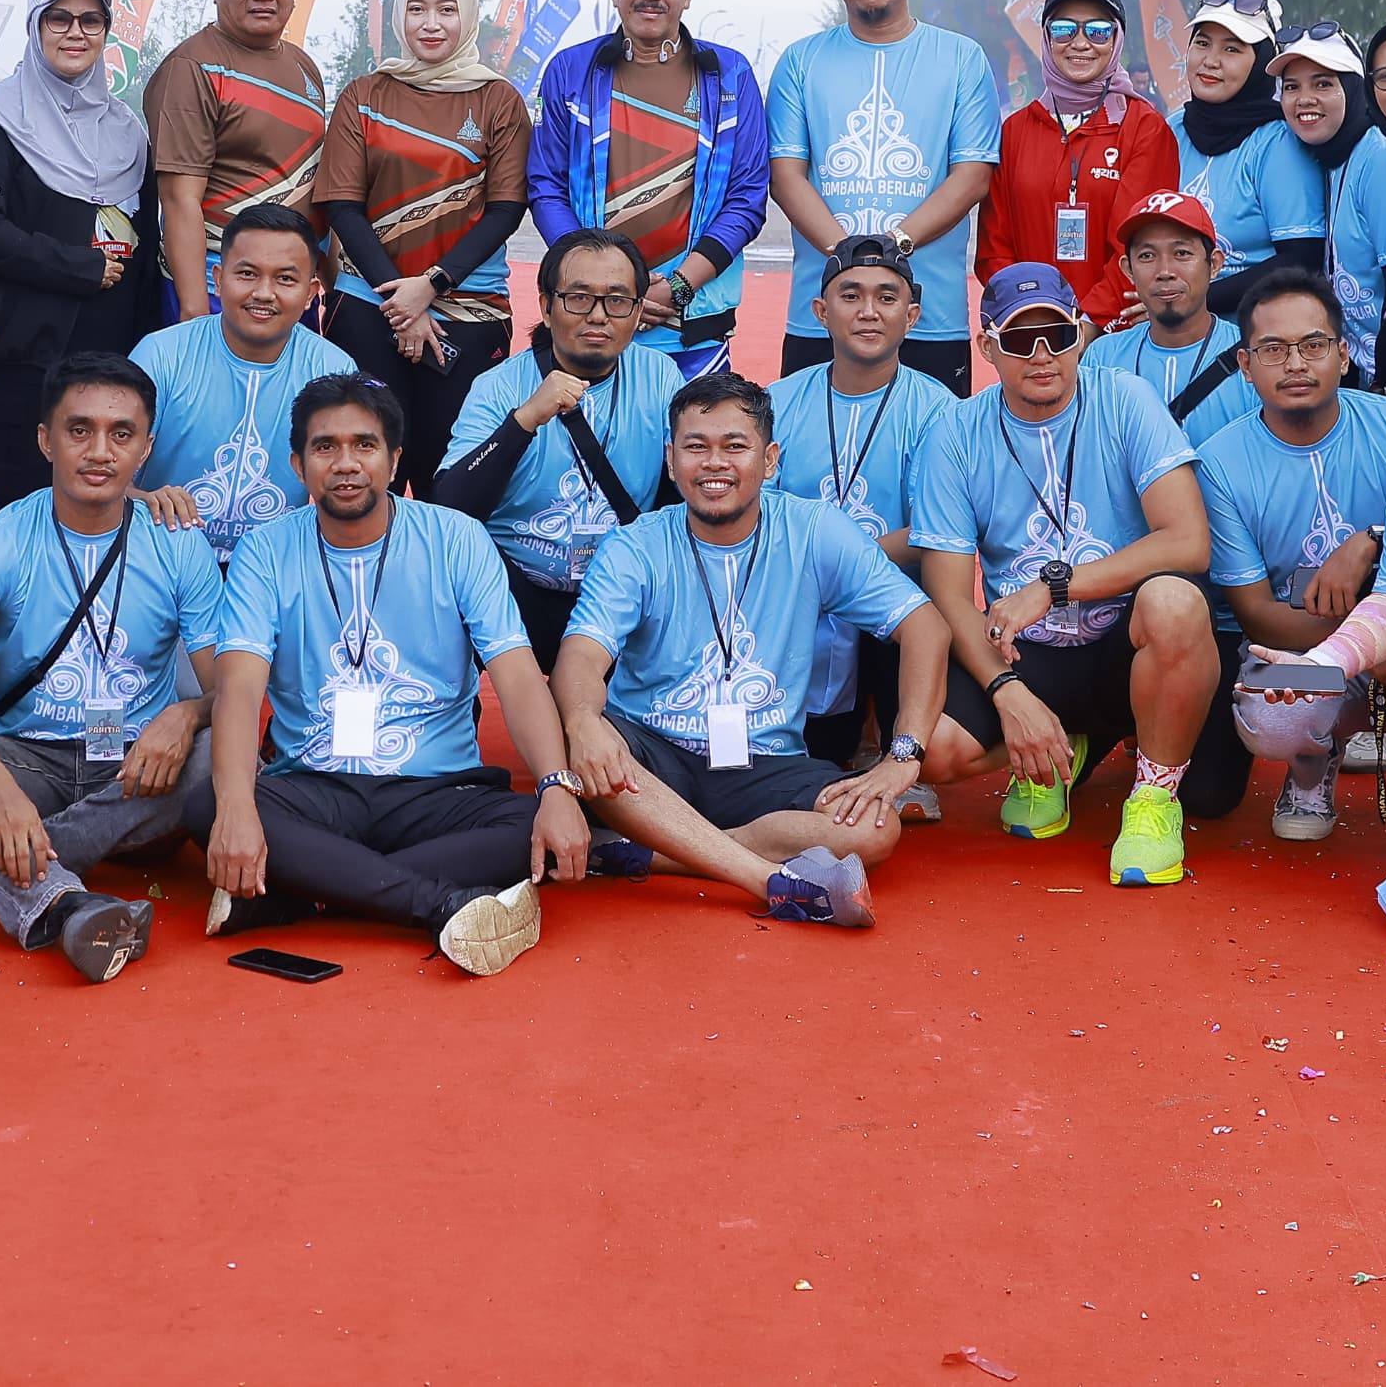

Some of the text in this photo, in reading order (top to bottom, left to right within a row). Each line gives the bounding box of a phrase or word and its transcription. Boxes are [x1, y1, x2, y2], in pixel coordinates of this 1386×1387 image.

[721, 93, 736, 102] BANA
[878, 180, 927, 198] BERLARI
[844, 198, 893, 207] 2025
[1343, 303, 1378, 321] ERLARI
[574, 548, 597, 556] PANIT
[642, 708, 787, 733] BOMBAN RLARI
[87, 726, 121, 734] PANITIA
